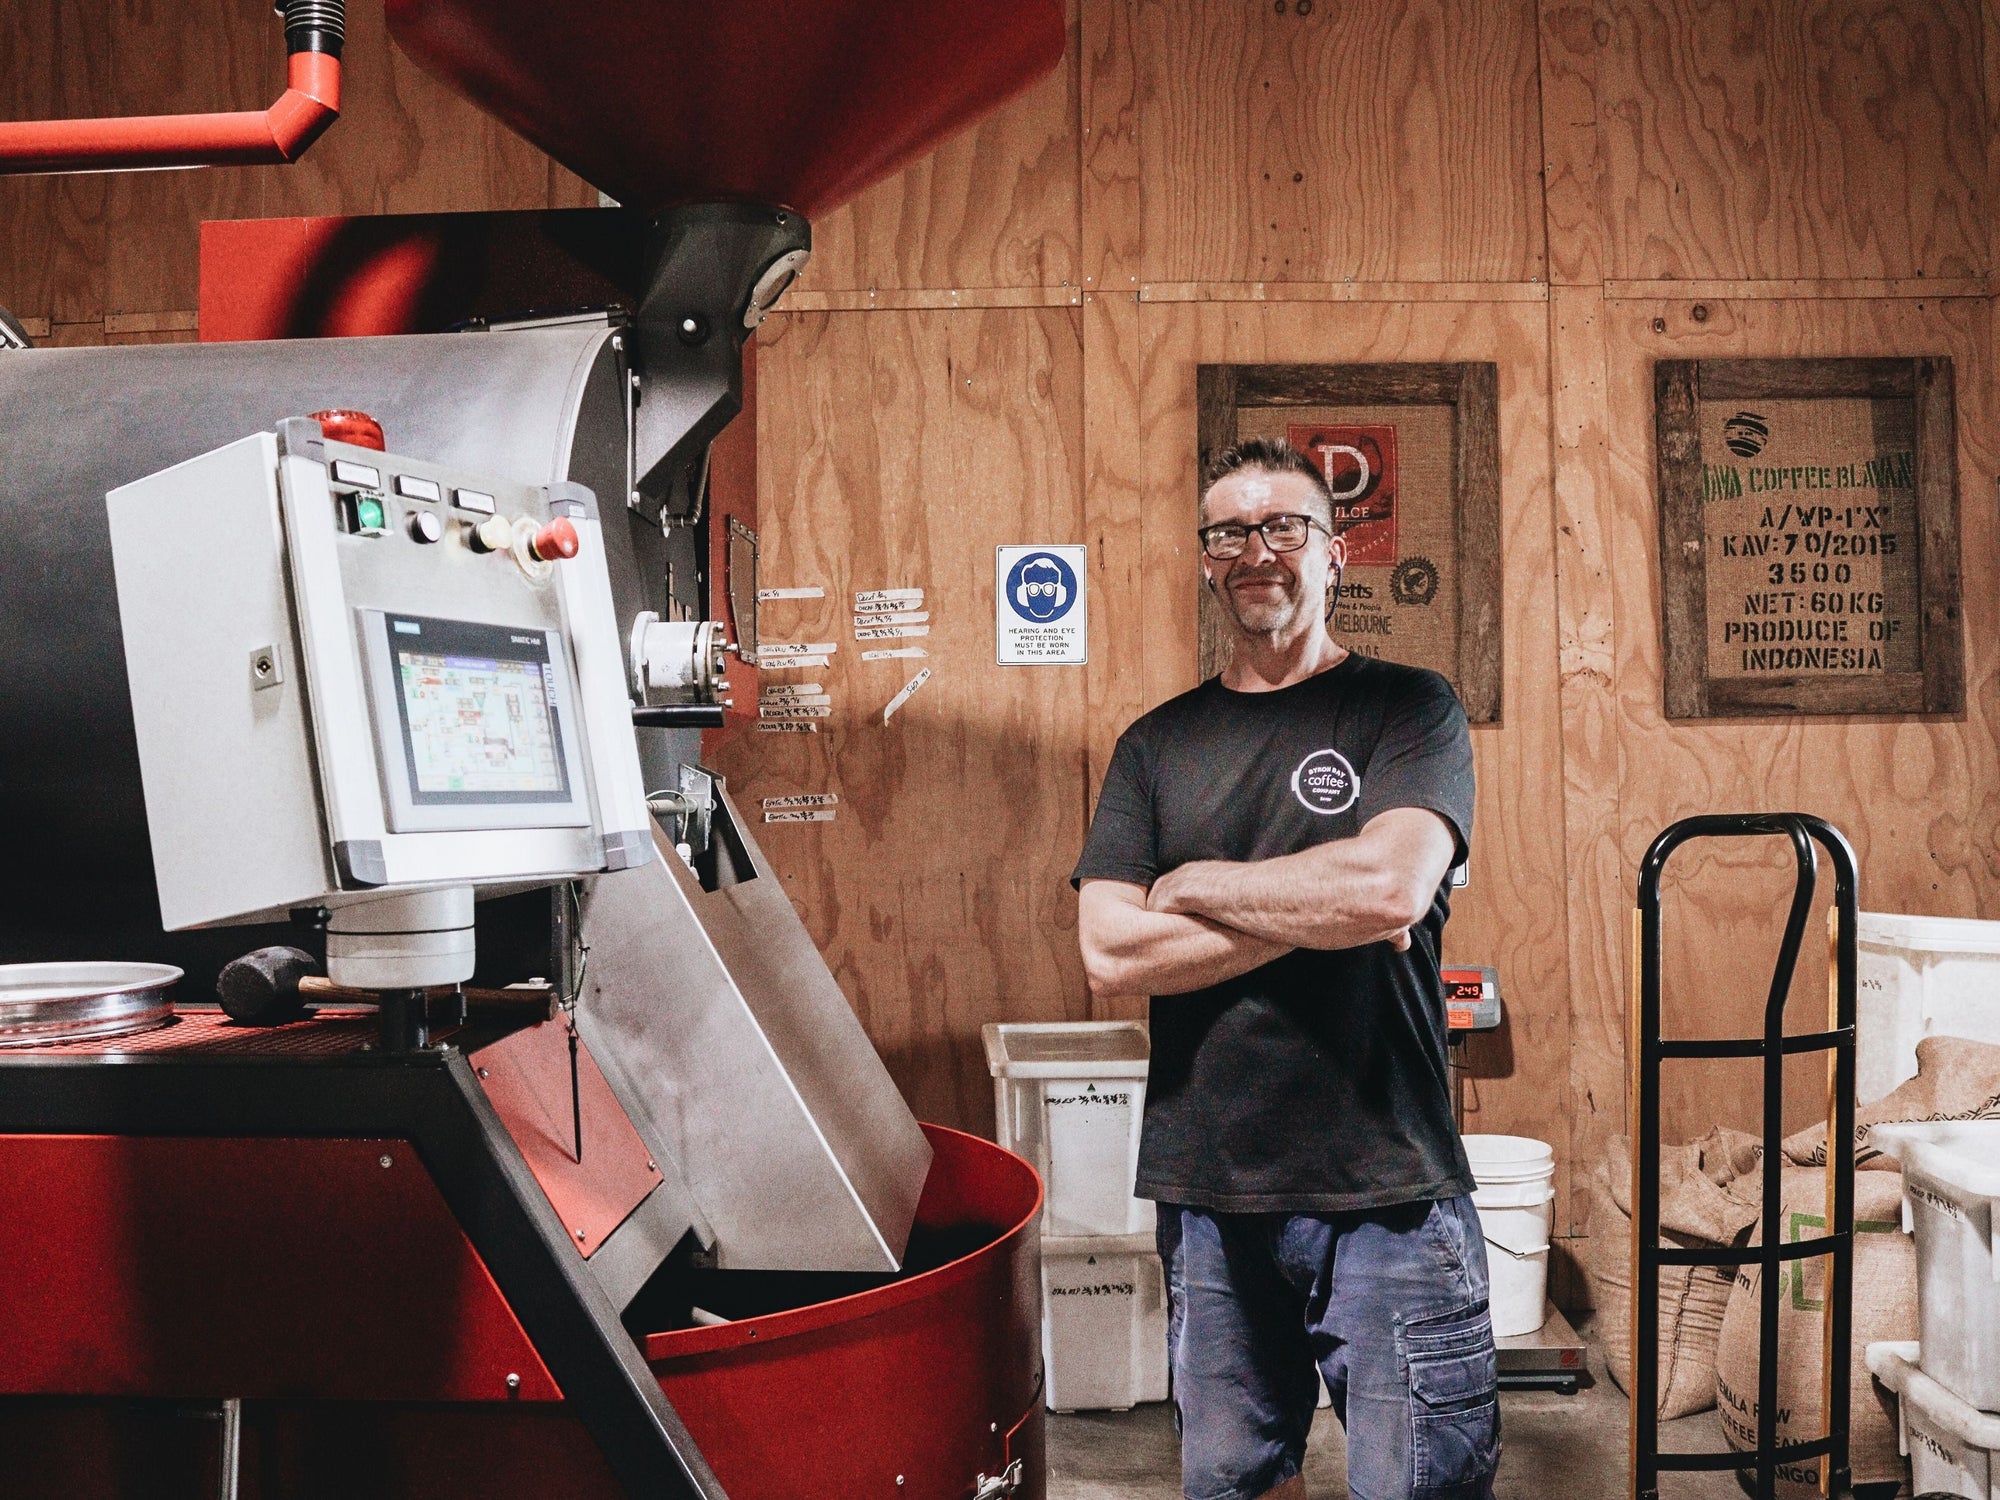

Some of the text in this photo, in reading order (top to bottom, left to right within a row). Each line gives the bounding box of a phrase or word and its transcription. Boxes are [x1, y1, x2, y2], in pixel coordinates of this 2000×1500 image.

[1317, 444, 1370, 499] D
[1749, 466, 1832, 492] COFFEE
[1768, 562, 1852, 585] 3500
[1334, 613, 1392, 635] MELBOURNE
[1725, 619, 1901, 643] PRODUCE OF
[1742, 648, 1882, 670] INDONESIA
[544, 665, 557, 707] TOUCH
[1308, 766, 1346, 778] BYRON BAY
[1308, 774, 1345, 788] coffee
[1312, 787, 1341, 795] COMPANY
[1456, 985, 1479, 996] 249
